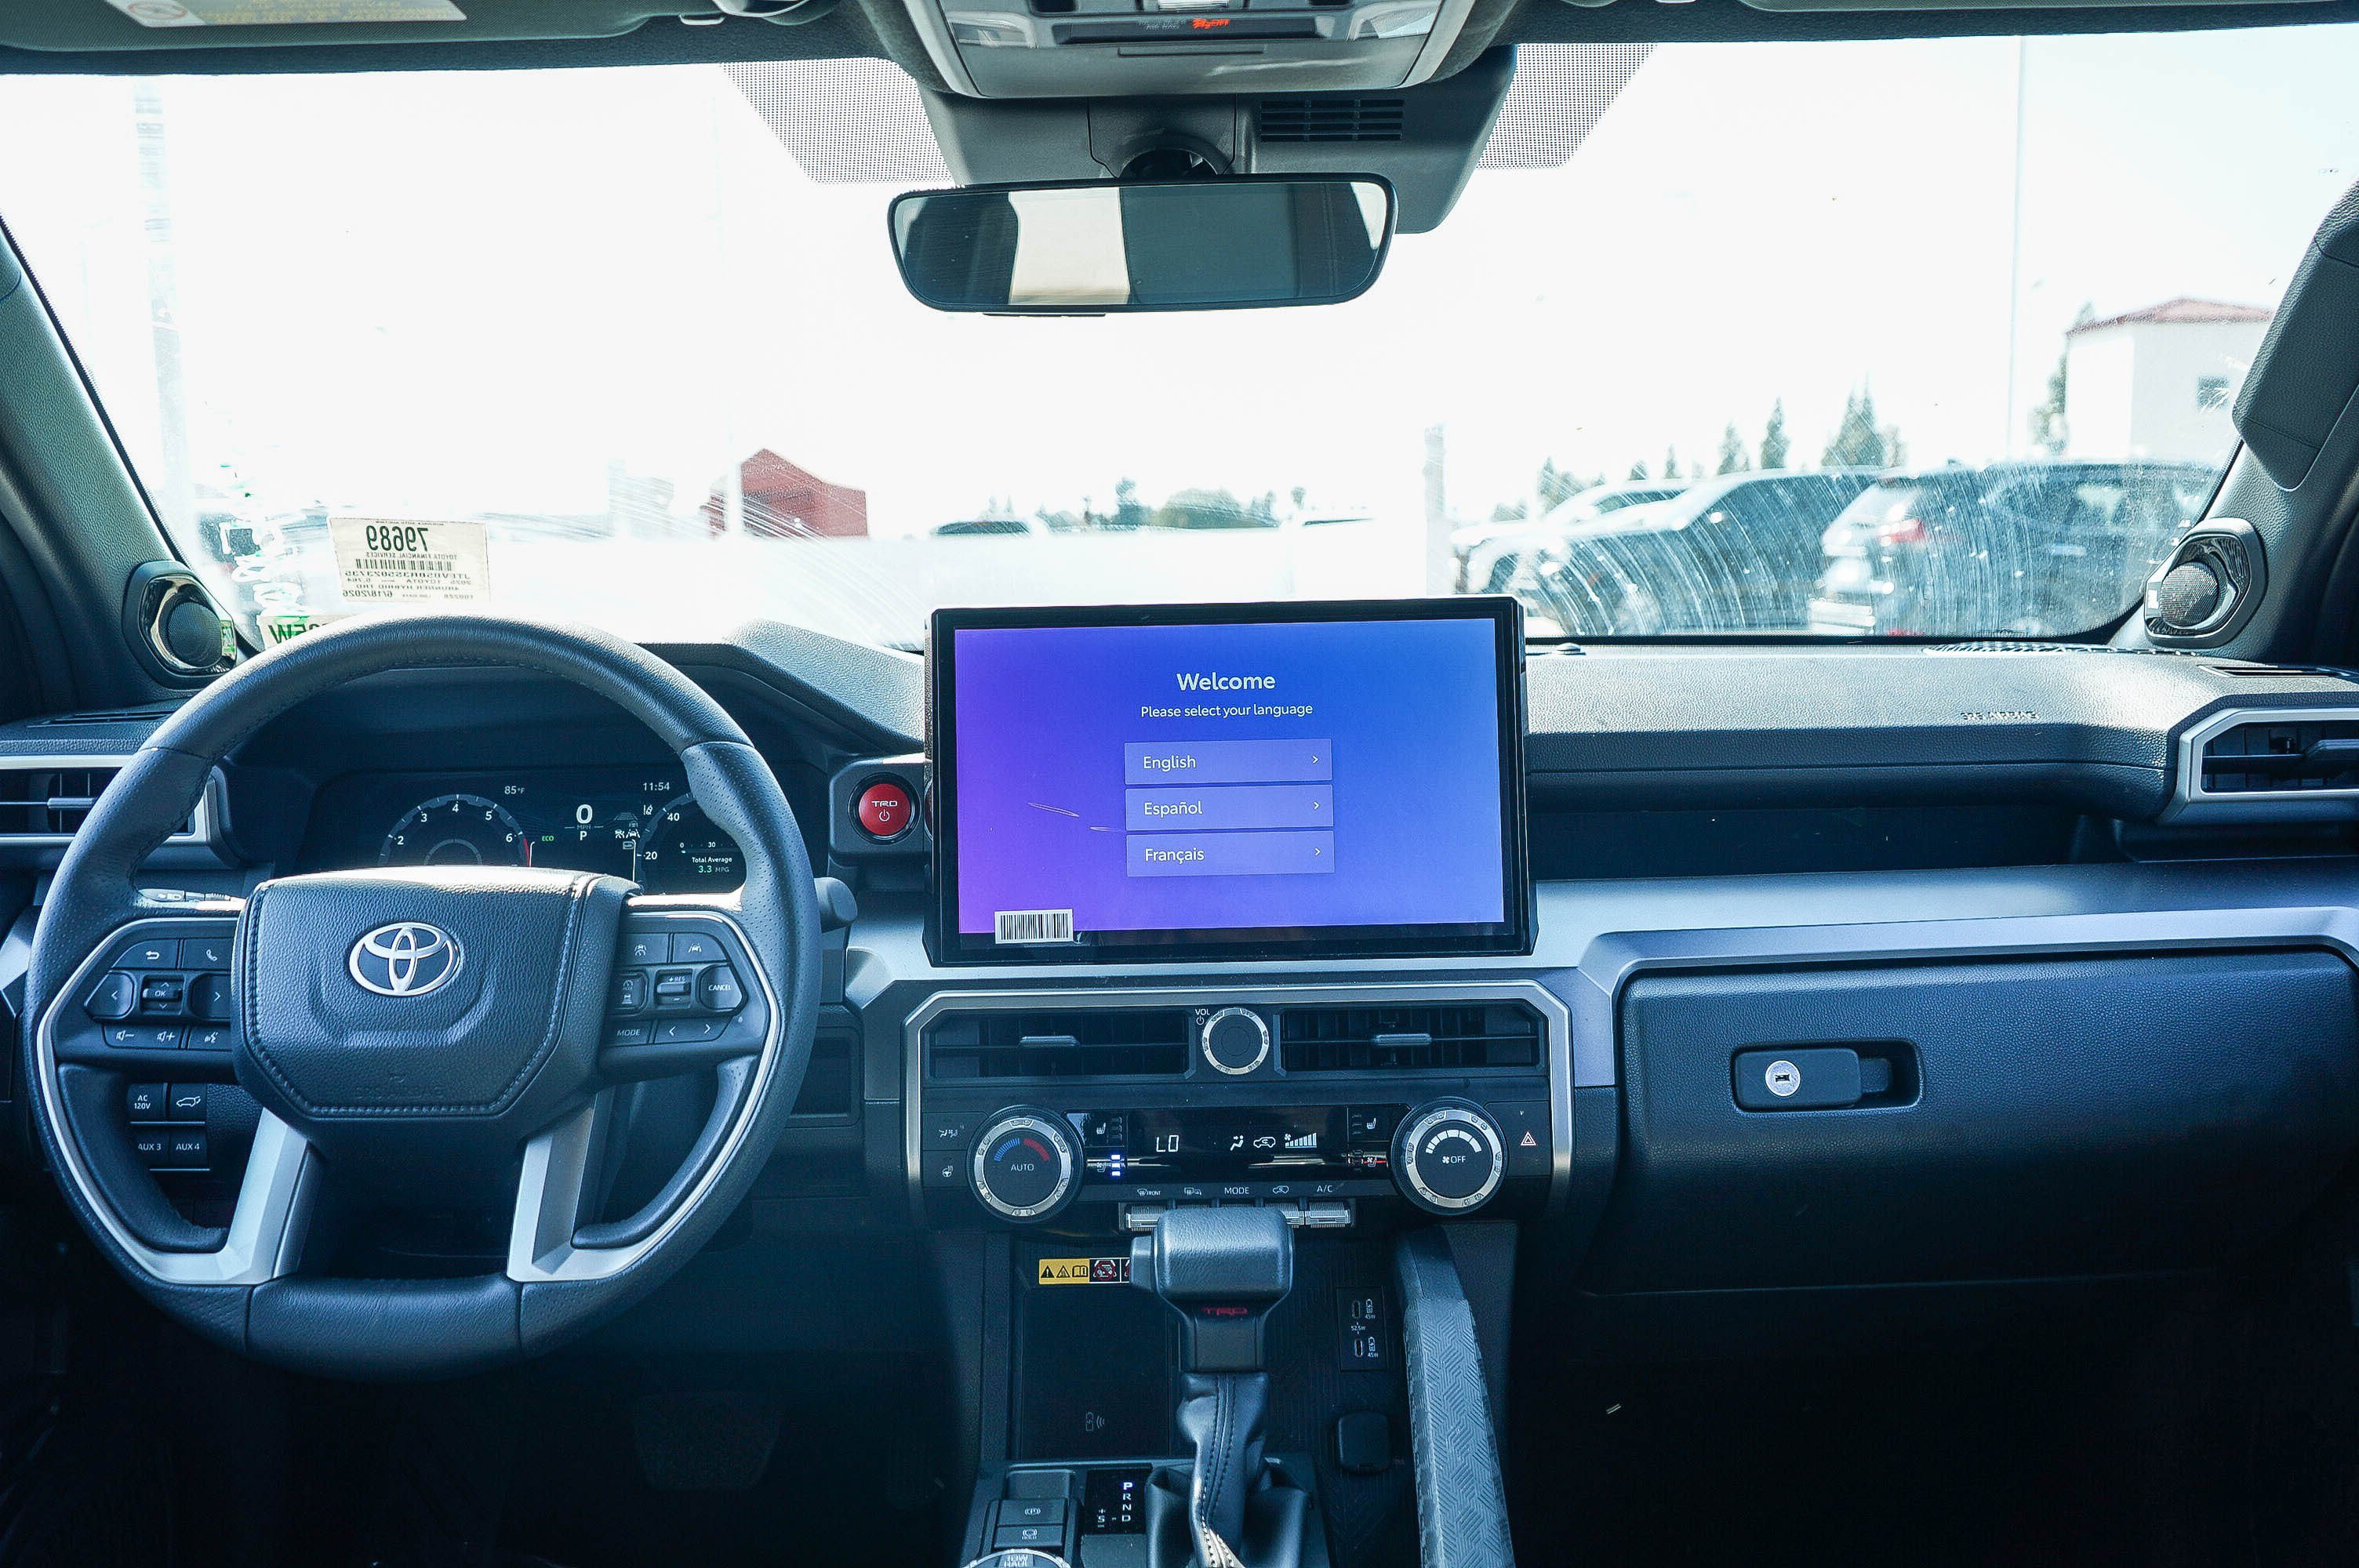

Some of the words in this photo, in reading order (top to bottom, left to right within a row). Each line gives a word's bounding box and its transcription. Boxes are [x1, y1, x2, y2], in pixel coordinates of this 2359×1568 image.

[1176, 672, 1276, 691] Welcome
[1140, 706, 1181, 717] Please
[1184, 705, 1221, 717] select
[1223, 706, 1252, 719] your
[1253, 703, 1314, 717] language
[1143, 755, 1197, 772] English
[643, 782, 670, 791] 11:54
[452, 804, 459, 812] 4
[1143, 800, 1204, 818] Español
[420, 813, 427, 822] 3
[485, 811, 493, 820] 5
[576, 804, 594, 824] 0
[667, 812, 680, 822] 40
[505, 833, 513, 843] 6
[580, 830, 587, 841] P
[397, 836, 405, 845] 2
[645, 851, 658, 860] 20
[1144, 847, 1205, 864] Français
[616, 1029, 641, 1037] MODE
[1010, 1163, 1034, 1171] AUTO
[1224, 1186, 1249, 1195] MODE
[1316, 1185, 1333, 1193] A/C
[1201, 1306, 1248, 1316] TRD
[1123, 1482, 1133, 1490] P
[1097, 1515, 1105, 1523] S
